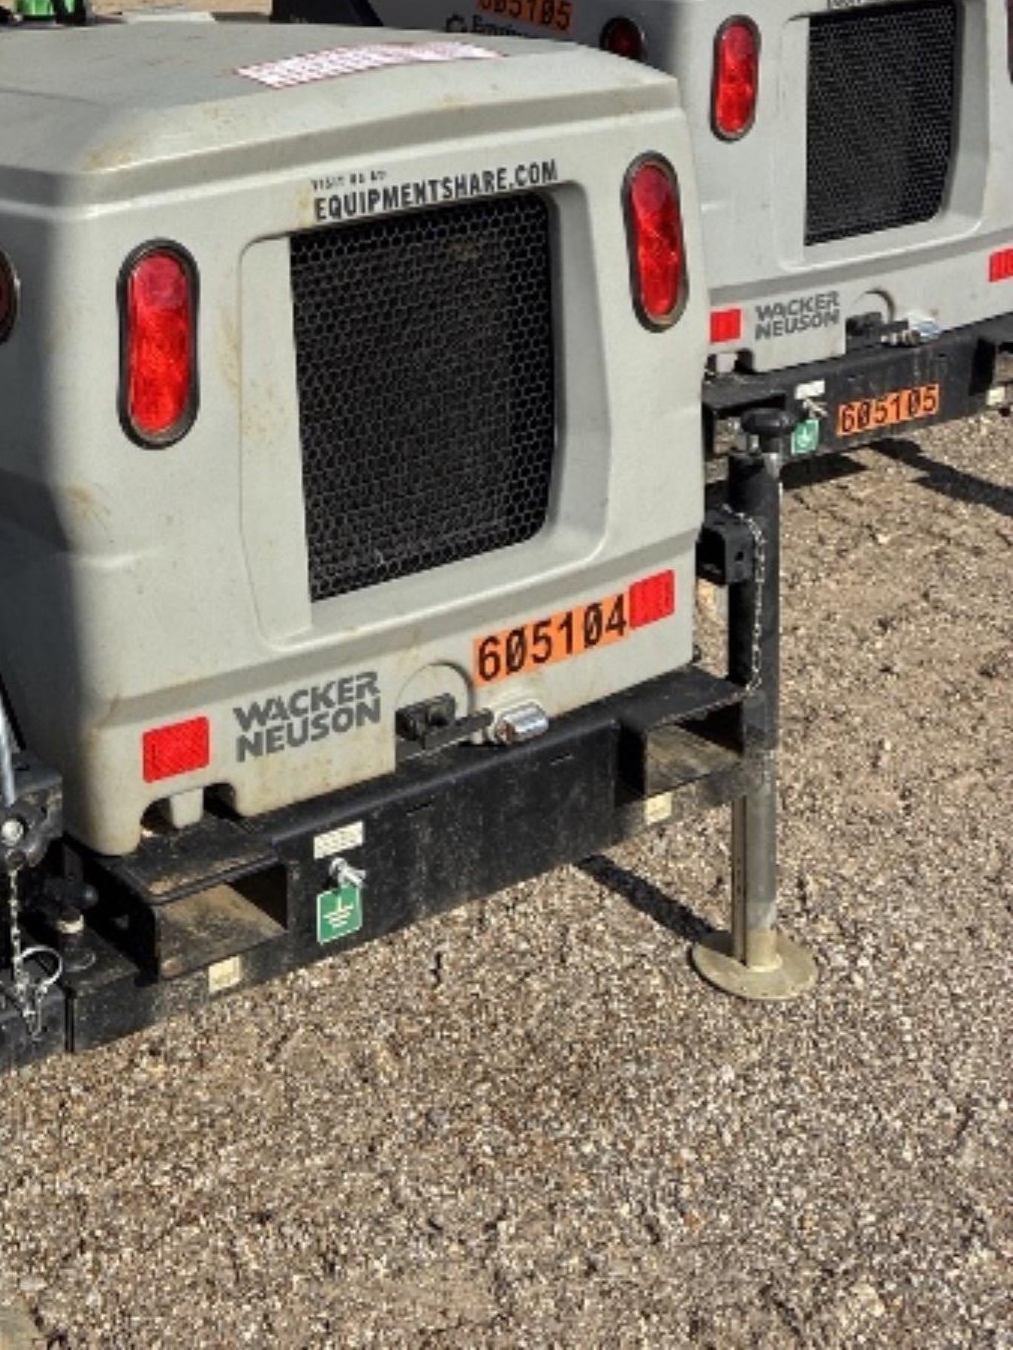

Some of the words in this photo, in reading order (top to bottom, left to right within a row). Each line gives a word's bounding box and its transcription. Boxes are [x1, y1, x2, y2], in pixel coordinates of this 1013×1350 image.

[313, 158, 559, 221] EQUIPMENTSHARE.COM
[754, 309, 841, 341] NEUSON
[755, 290, 841, 323] WACKER
[841, 385, 937, 433] 605105
[477, 594, 628, 681] 605104
[232, 670, 381, 732] WACKER
[235, 698, 381, 763] NEUSON
